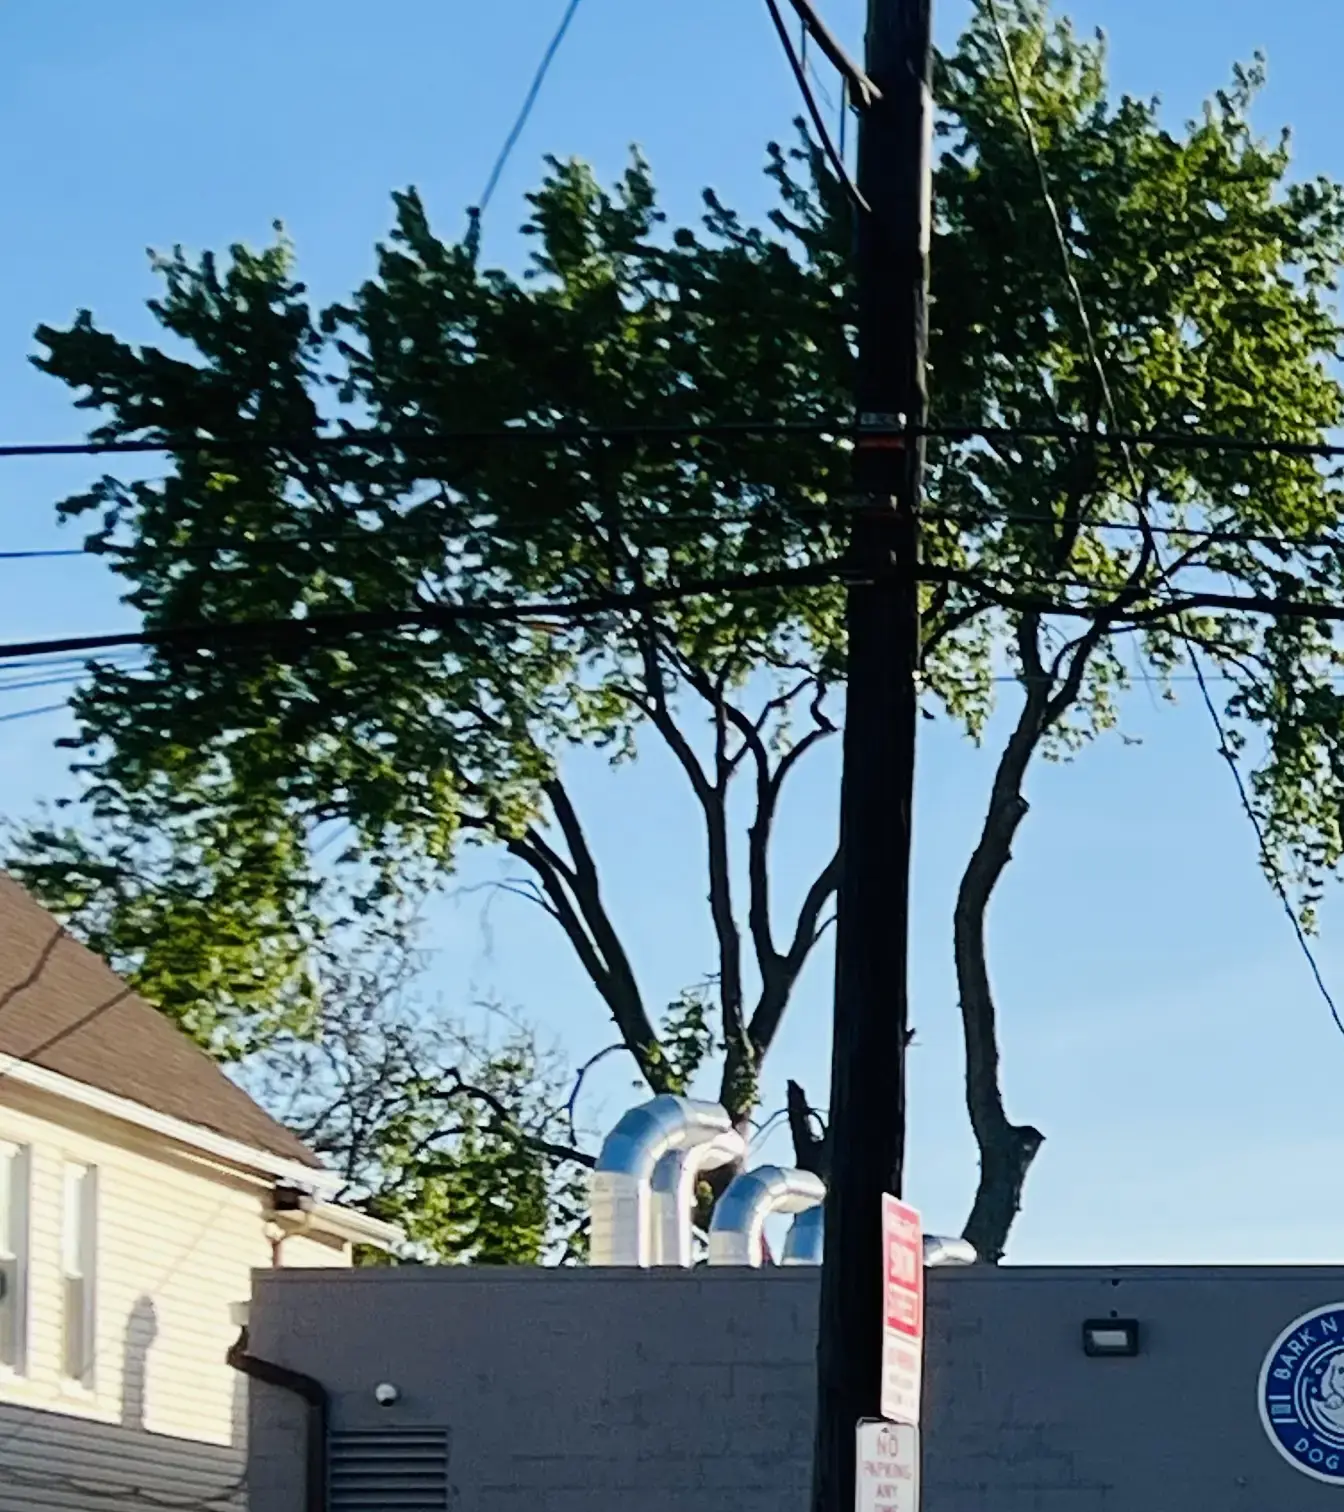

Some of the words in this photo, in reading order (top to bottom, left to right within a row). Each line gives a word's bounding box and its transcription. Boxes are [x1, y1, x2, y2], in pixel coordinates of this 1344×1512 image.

[1273, 1328, 1317, 1380] BARK
[876, 1434, 898, 1457] NO
[1293, 1437, 1340, 1470] DOG
[863, 1461, 912, 1480] PARKING
[876, 1483, 899, 1498] ANY
